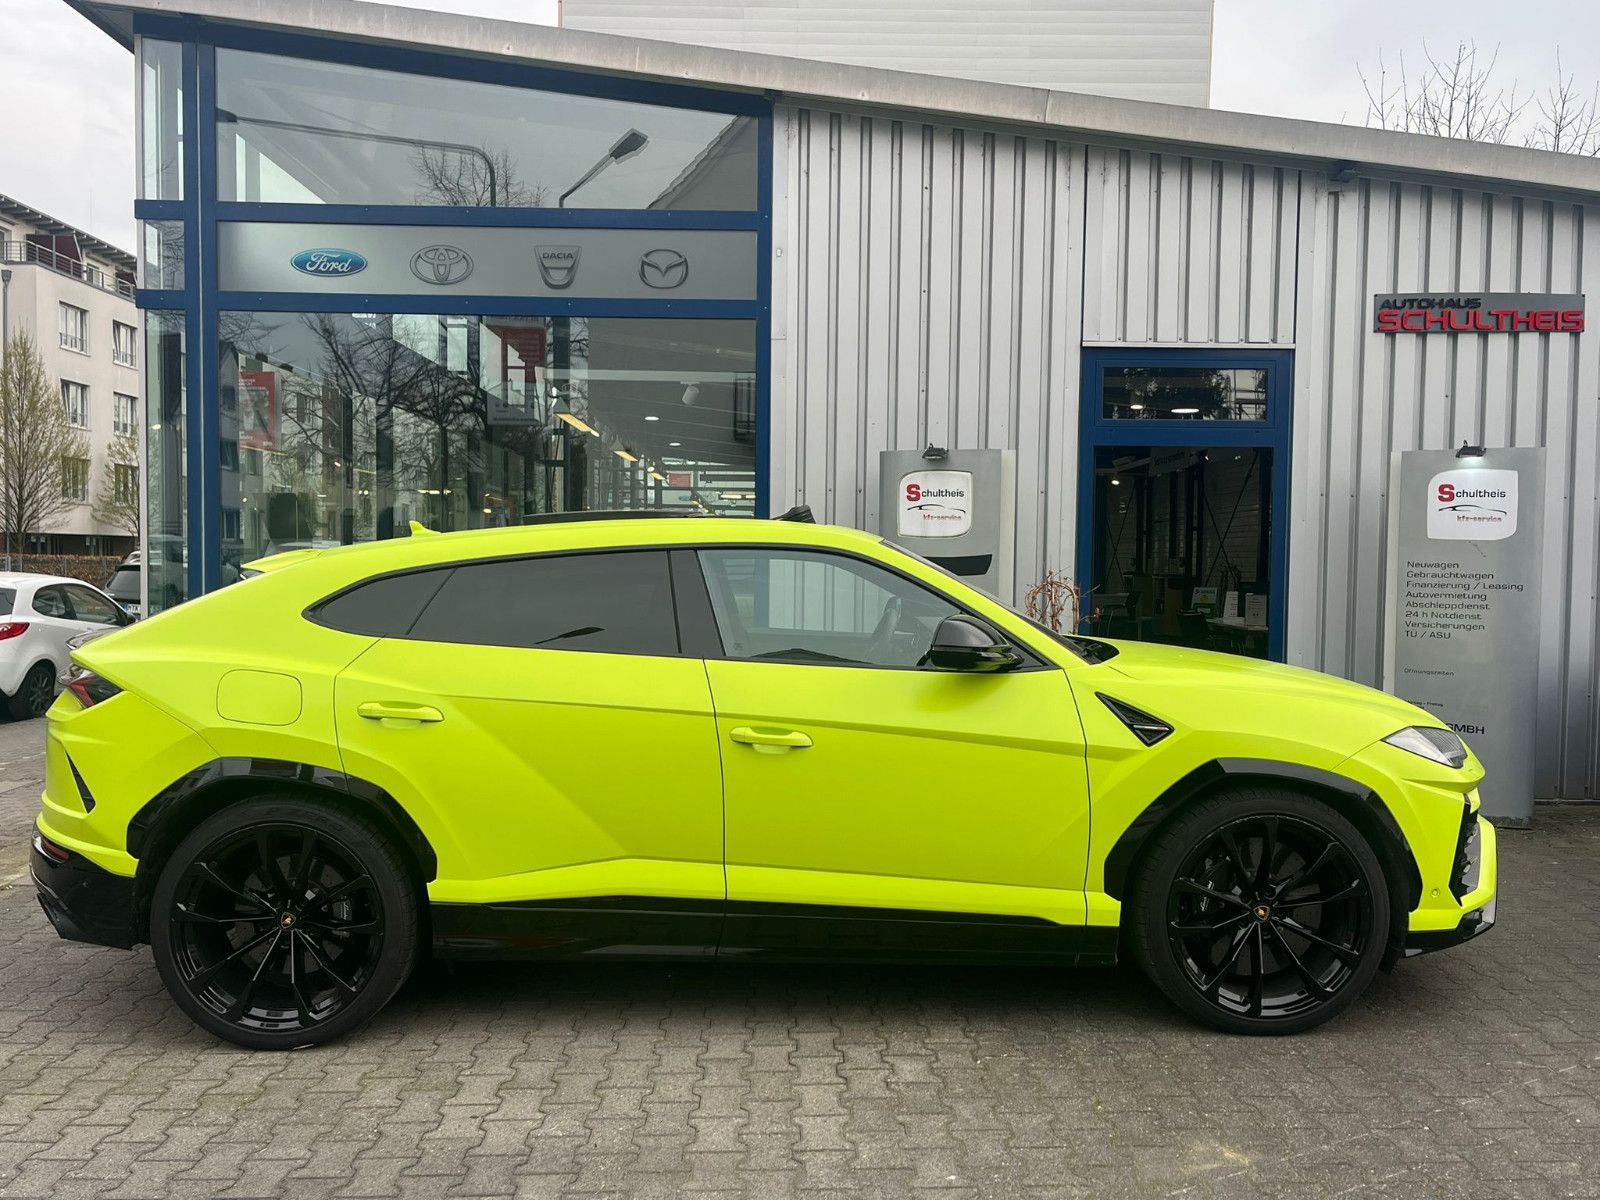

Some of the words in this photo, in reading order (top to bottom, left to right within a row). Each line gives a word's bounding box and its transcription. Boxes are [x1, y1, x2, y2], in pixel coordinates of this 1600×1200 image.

[306, 252, 352, 271] Ford
[542, 252, 574, 260] DACIA
[1379, 298, 1481, 310] AUTOHAUS
[1378, 309, 1585, 331] SCHULTHEIS
[906, 484, 965, 502] Schultheis
[1437, 483, 1506, 502] Schultheis
[1406, 561, 1460, 570] Neuwagen
[1406, 570, 1494, 581] Gebrauchtwagen
[1406, 580, 1471, 591] Finanzierung
[1482, 582, 1524, 592] Leasing
[1405, 591, 1487, 602] Autovermietung
[1405, 600, 1490, 610] Abschleppdienst
[1405, 610, 1419, 618] 24
[1430, 611, 1482, 621] Notdienst
[1405, 620, 1485, 632] Versicherungen
[1429, 631, 1451, 640] ASU
